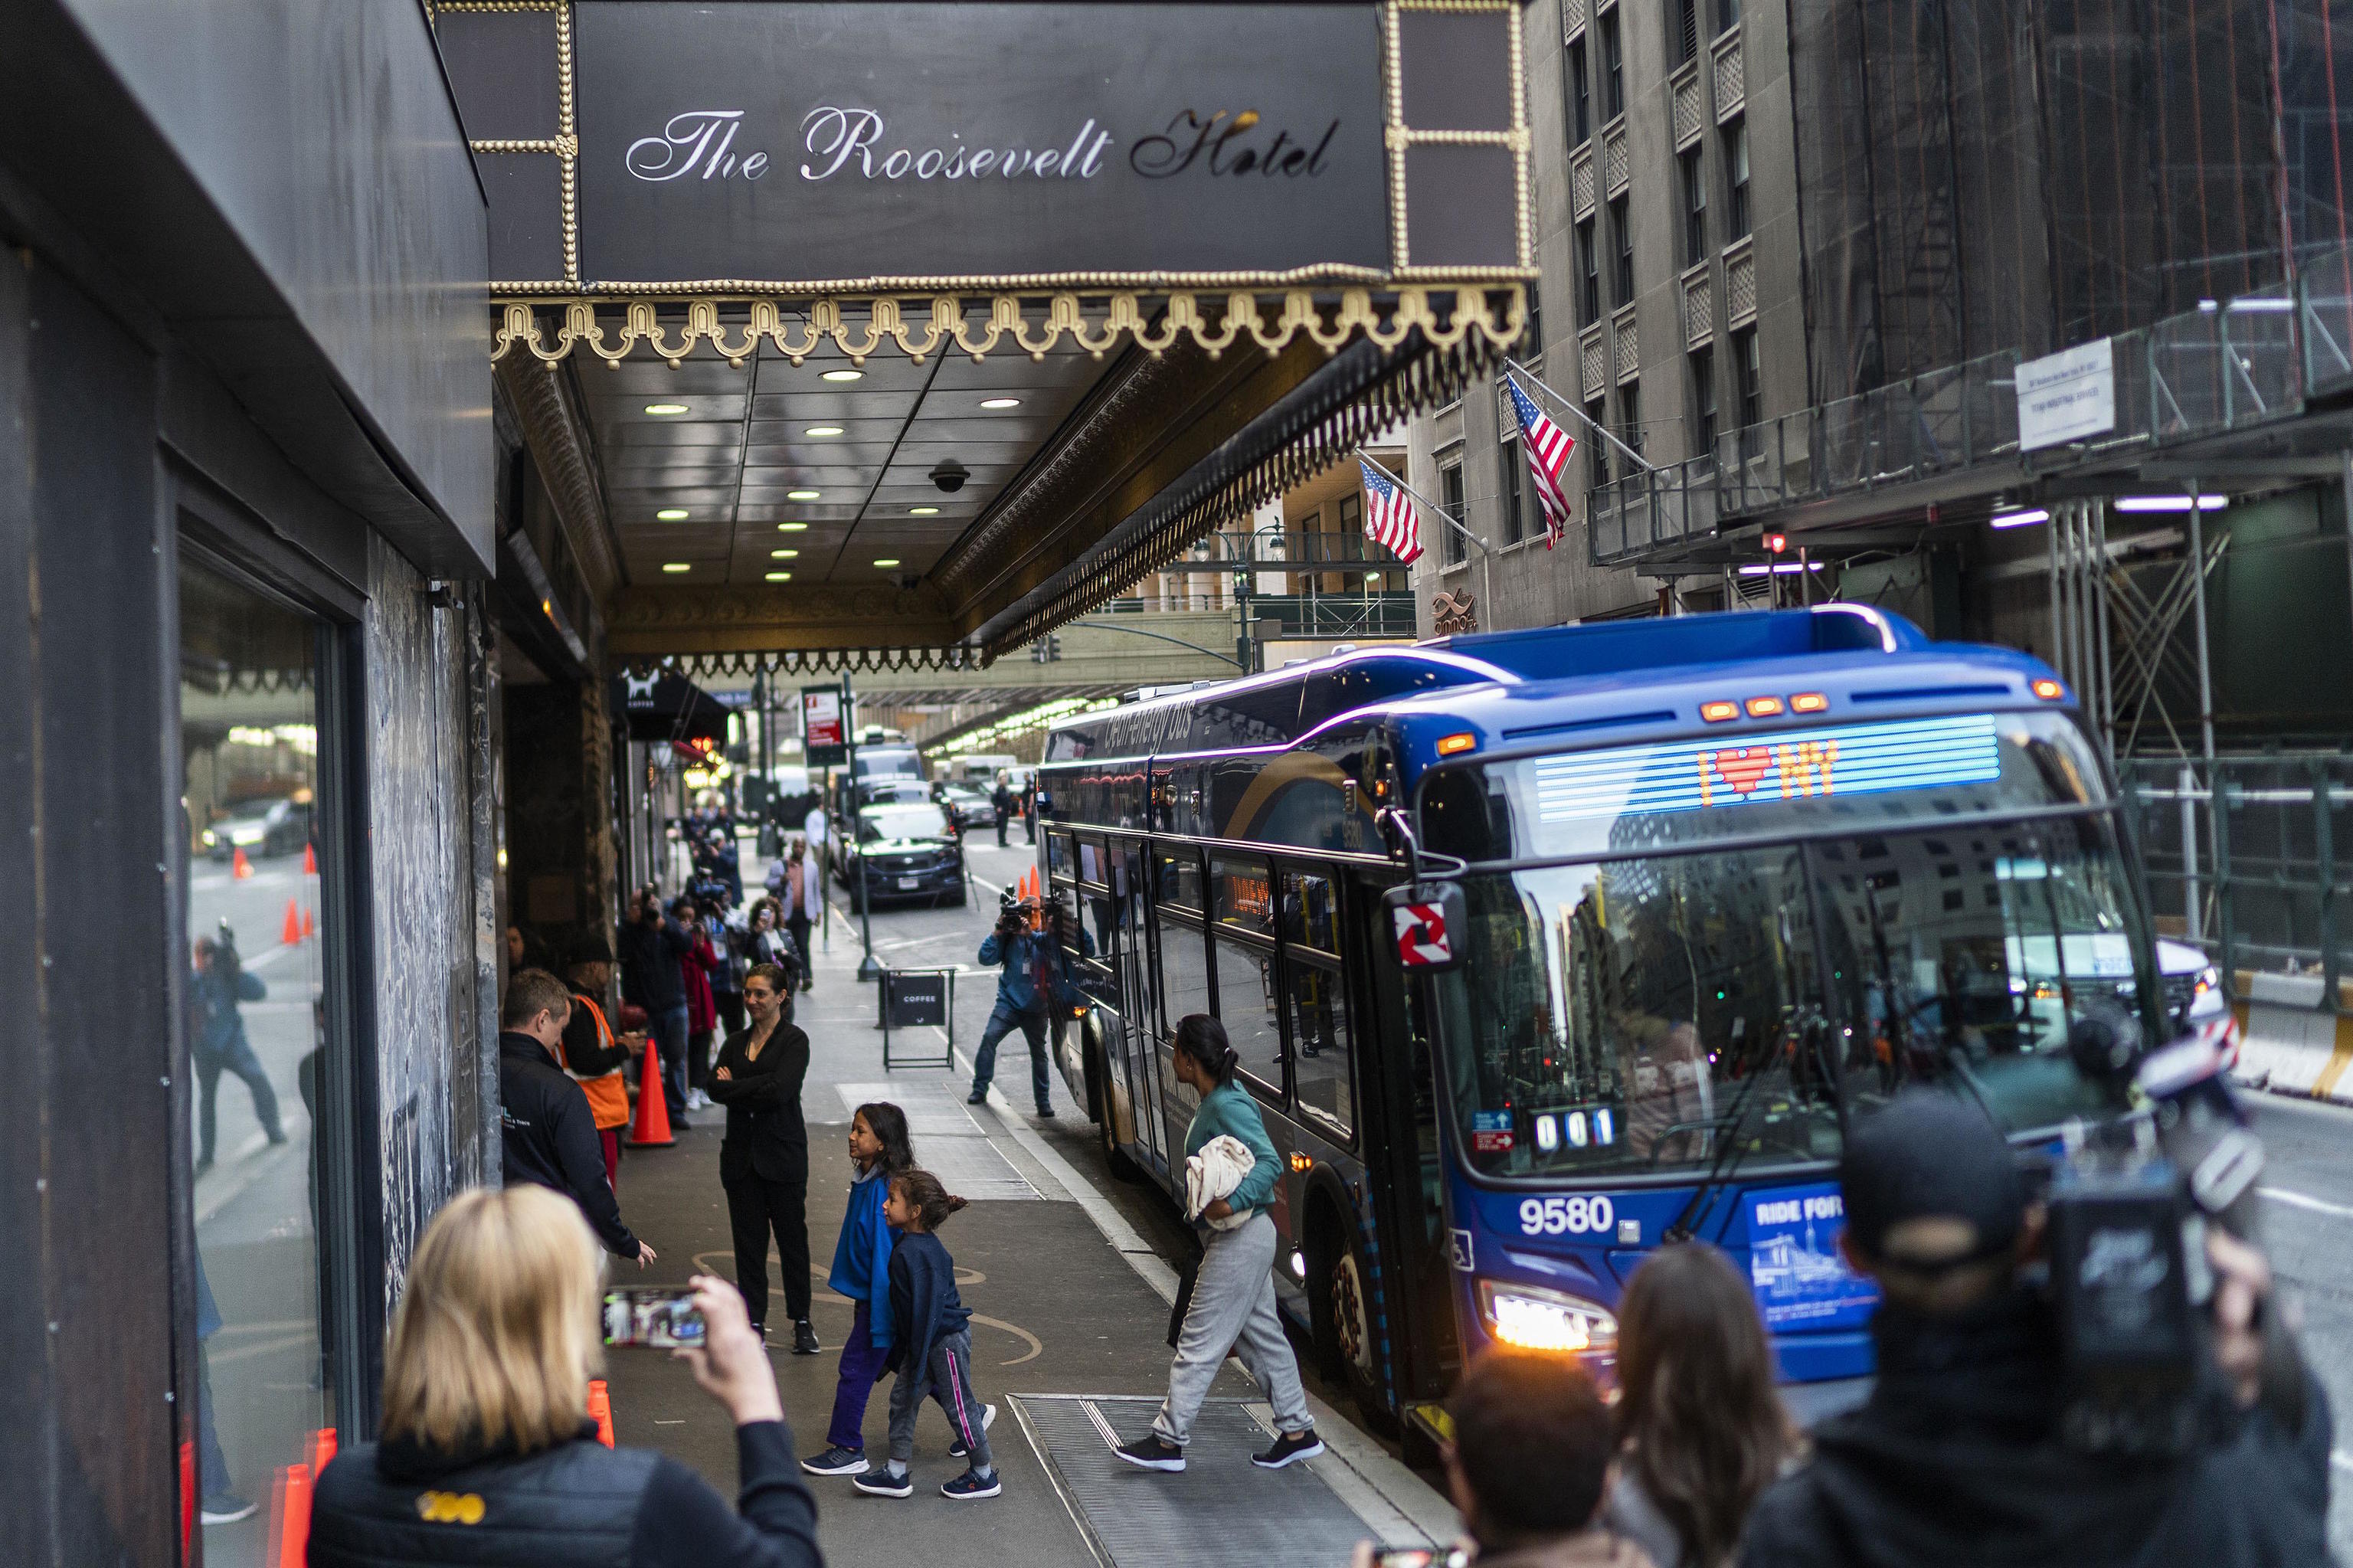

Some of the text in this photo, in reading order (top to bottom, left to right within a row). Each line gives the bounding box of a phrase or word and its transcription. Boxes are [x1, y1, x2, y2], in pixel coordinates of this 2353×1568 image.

[625, 106, 1340, 182] The Roosevelt Hotel
[1778, 739, 1840, 799] NY
[1519, 1196, 1614, 1235] 9580
[1756, 1200, 1802, 1226] RIDE
